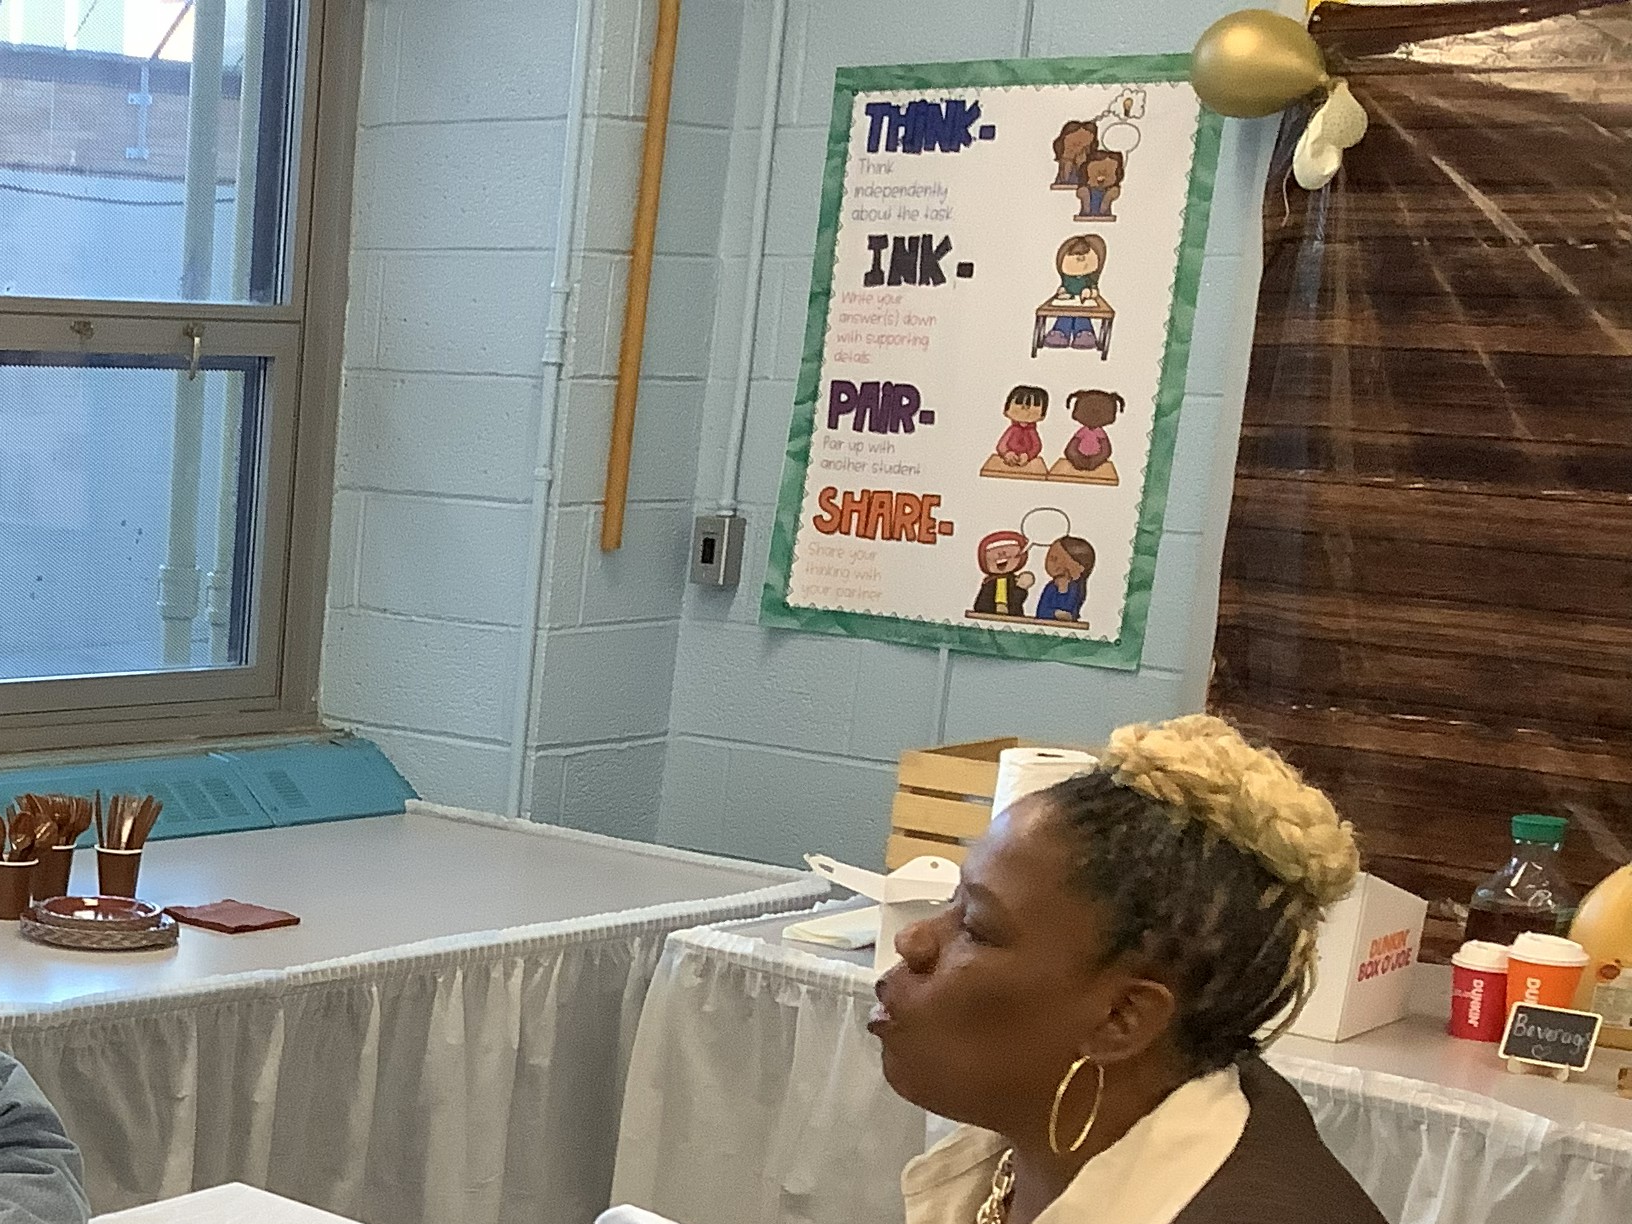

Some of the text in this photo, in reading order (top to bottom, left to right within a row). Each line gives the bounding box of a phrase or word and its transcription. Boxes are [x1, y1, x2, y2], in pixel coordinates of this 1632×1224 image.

[858, 158, 894, 175] Think
[853, 181, 948, 204] independently
[851, 205, 891, 221] about
[897, 205, 919, 221] the
[841, 291, 903, 309] Write your
[839, 309, 936, 327] answer(s) down
[837, 329, 929, 351] with supporting
[823, 435, 895, 456] Pair up with
[820, 457, 920, 475] another student
[808, 541, 877, 565] Share your
[805, 561, 882, 582] thinking with
[801, 584, 831, 600] your
[1358, 959, 1380, 982] BOX
